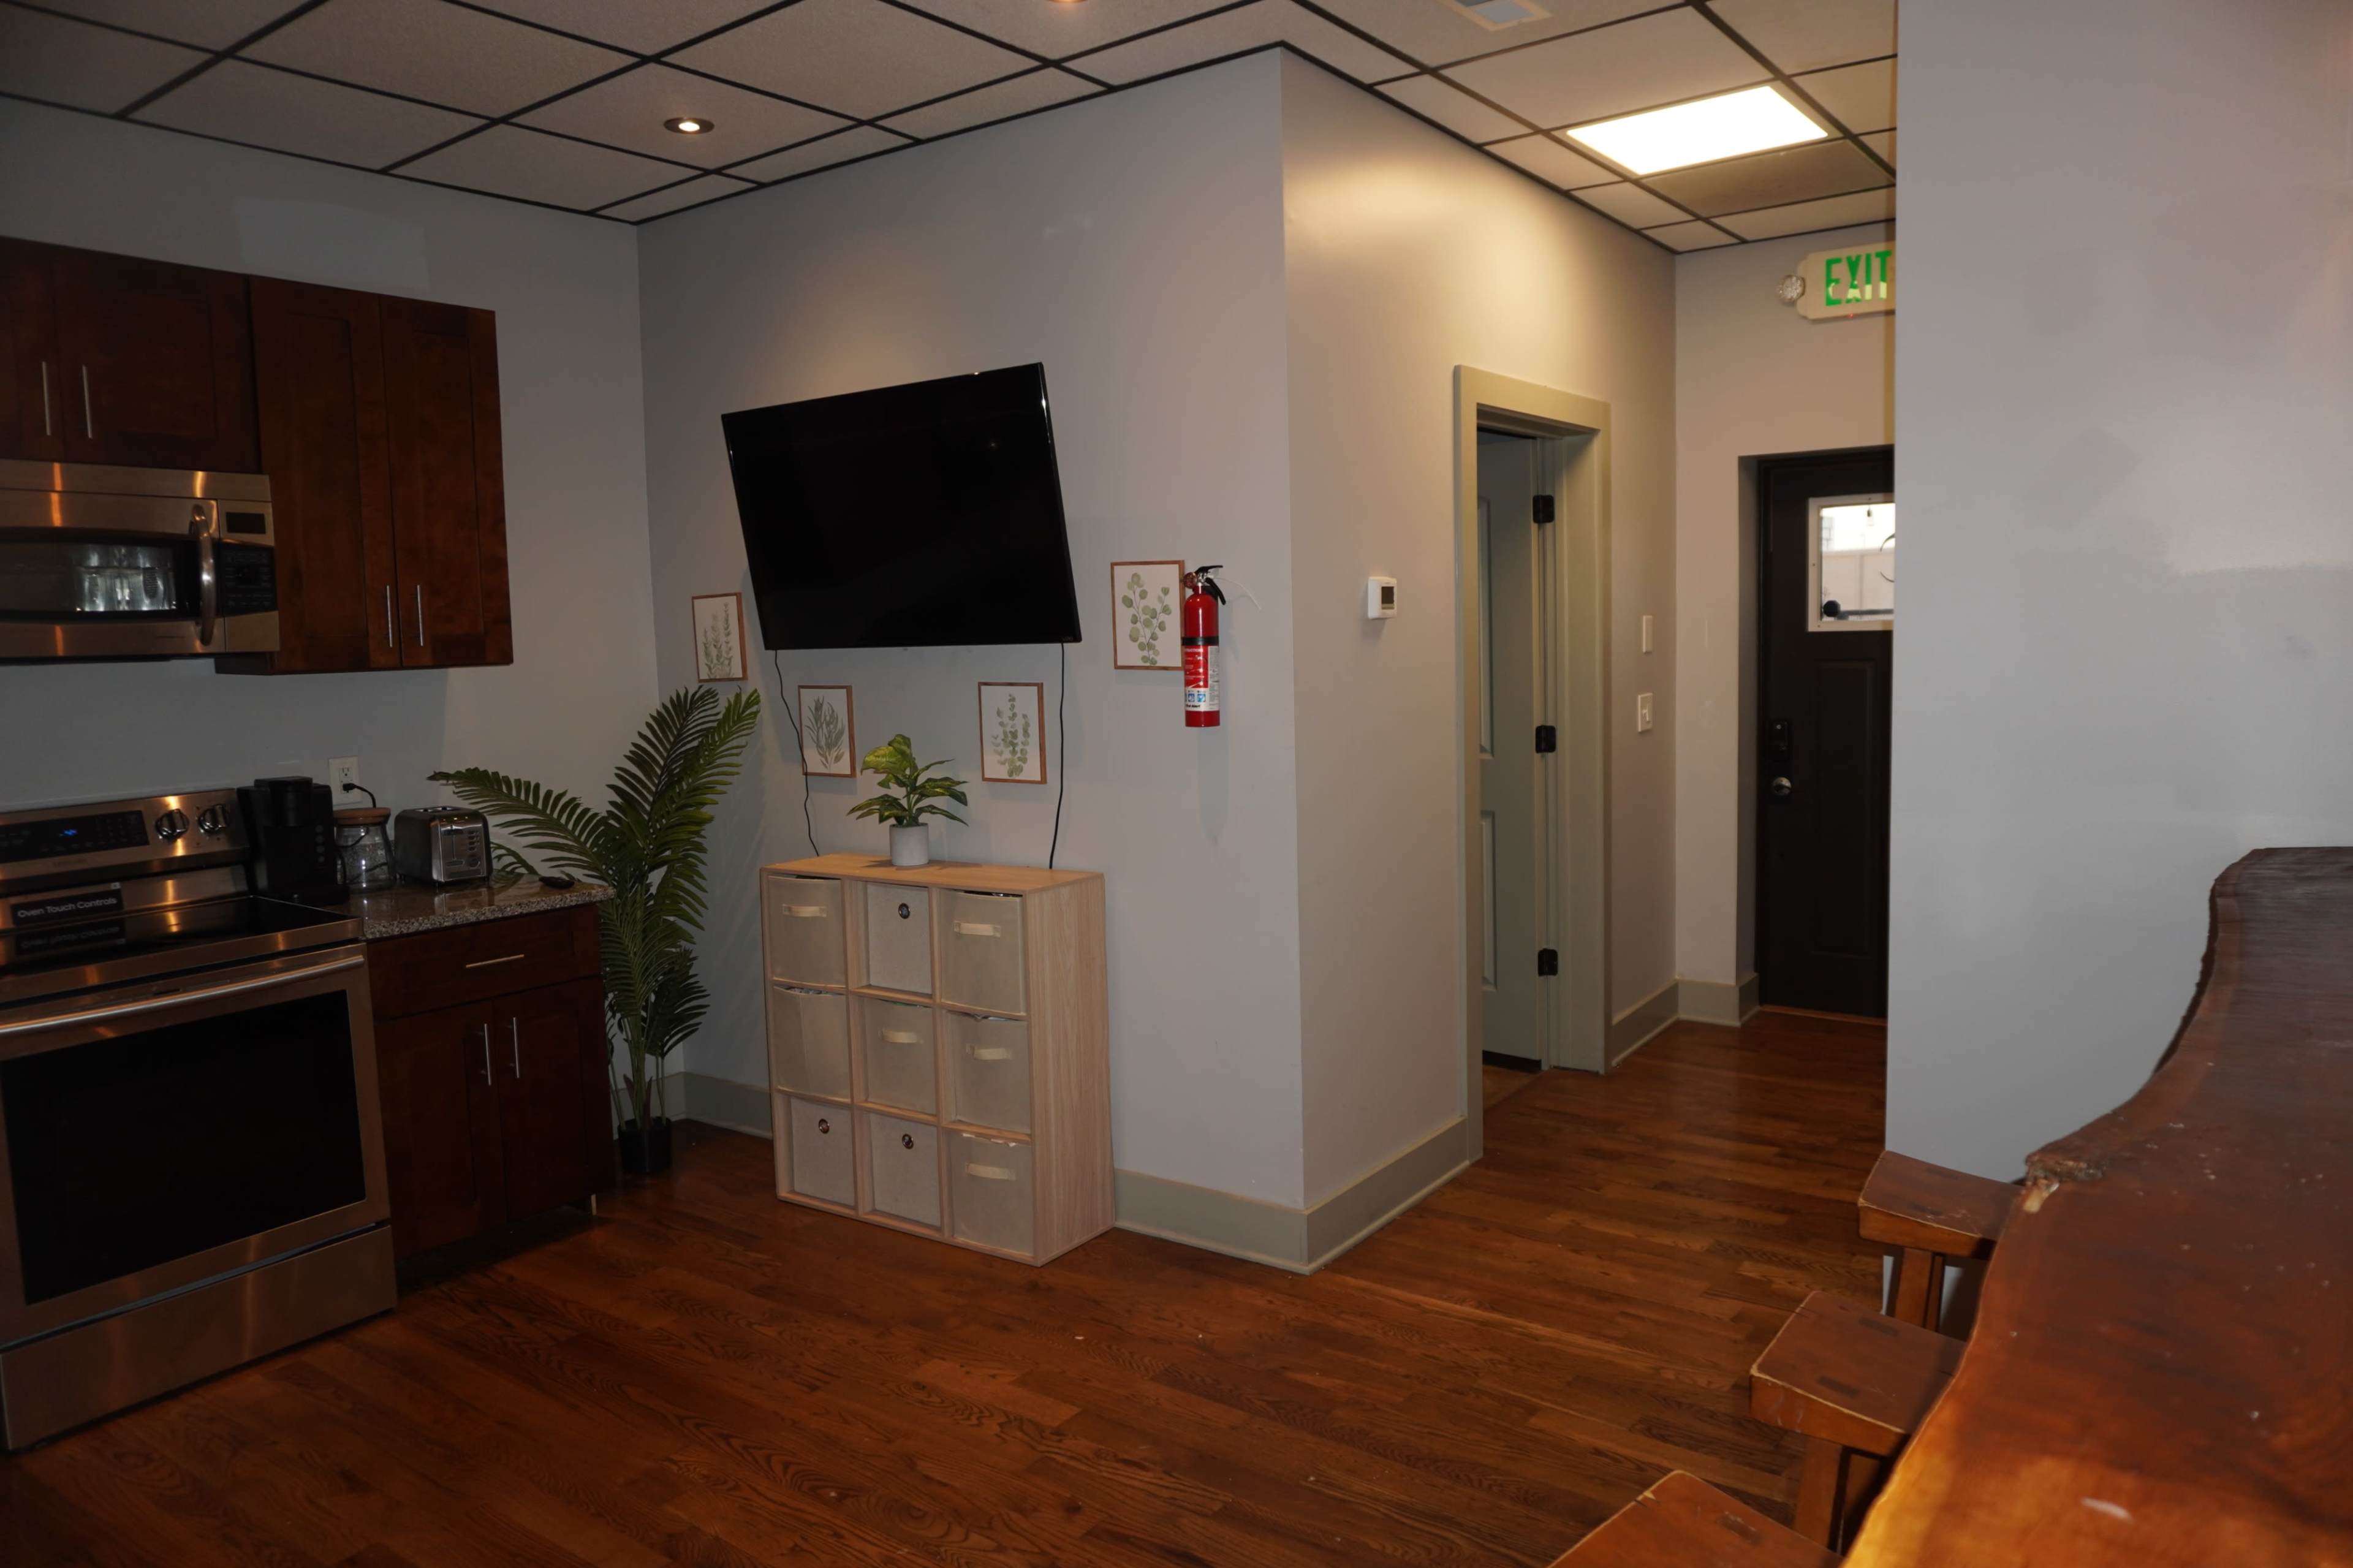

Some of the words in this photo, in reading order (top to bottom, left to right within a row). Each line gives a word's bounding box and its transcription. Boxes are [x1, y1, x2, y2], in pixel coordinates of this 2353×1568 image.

[1825, 249, 1893, 306] EXIT
[17, 909, 45, 917] Oven
[46, 903, 76, 913] Touch
[77, 897, 118, 909] Controls
